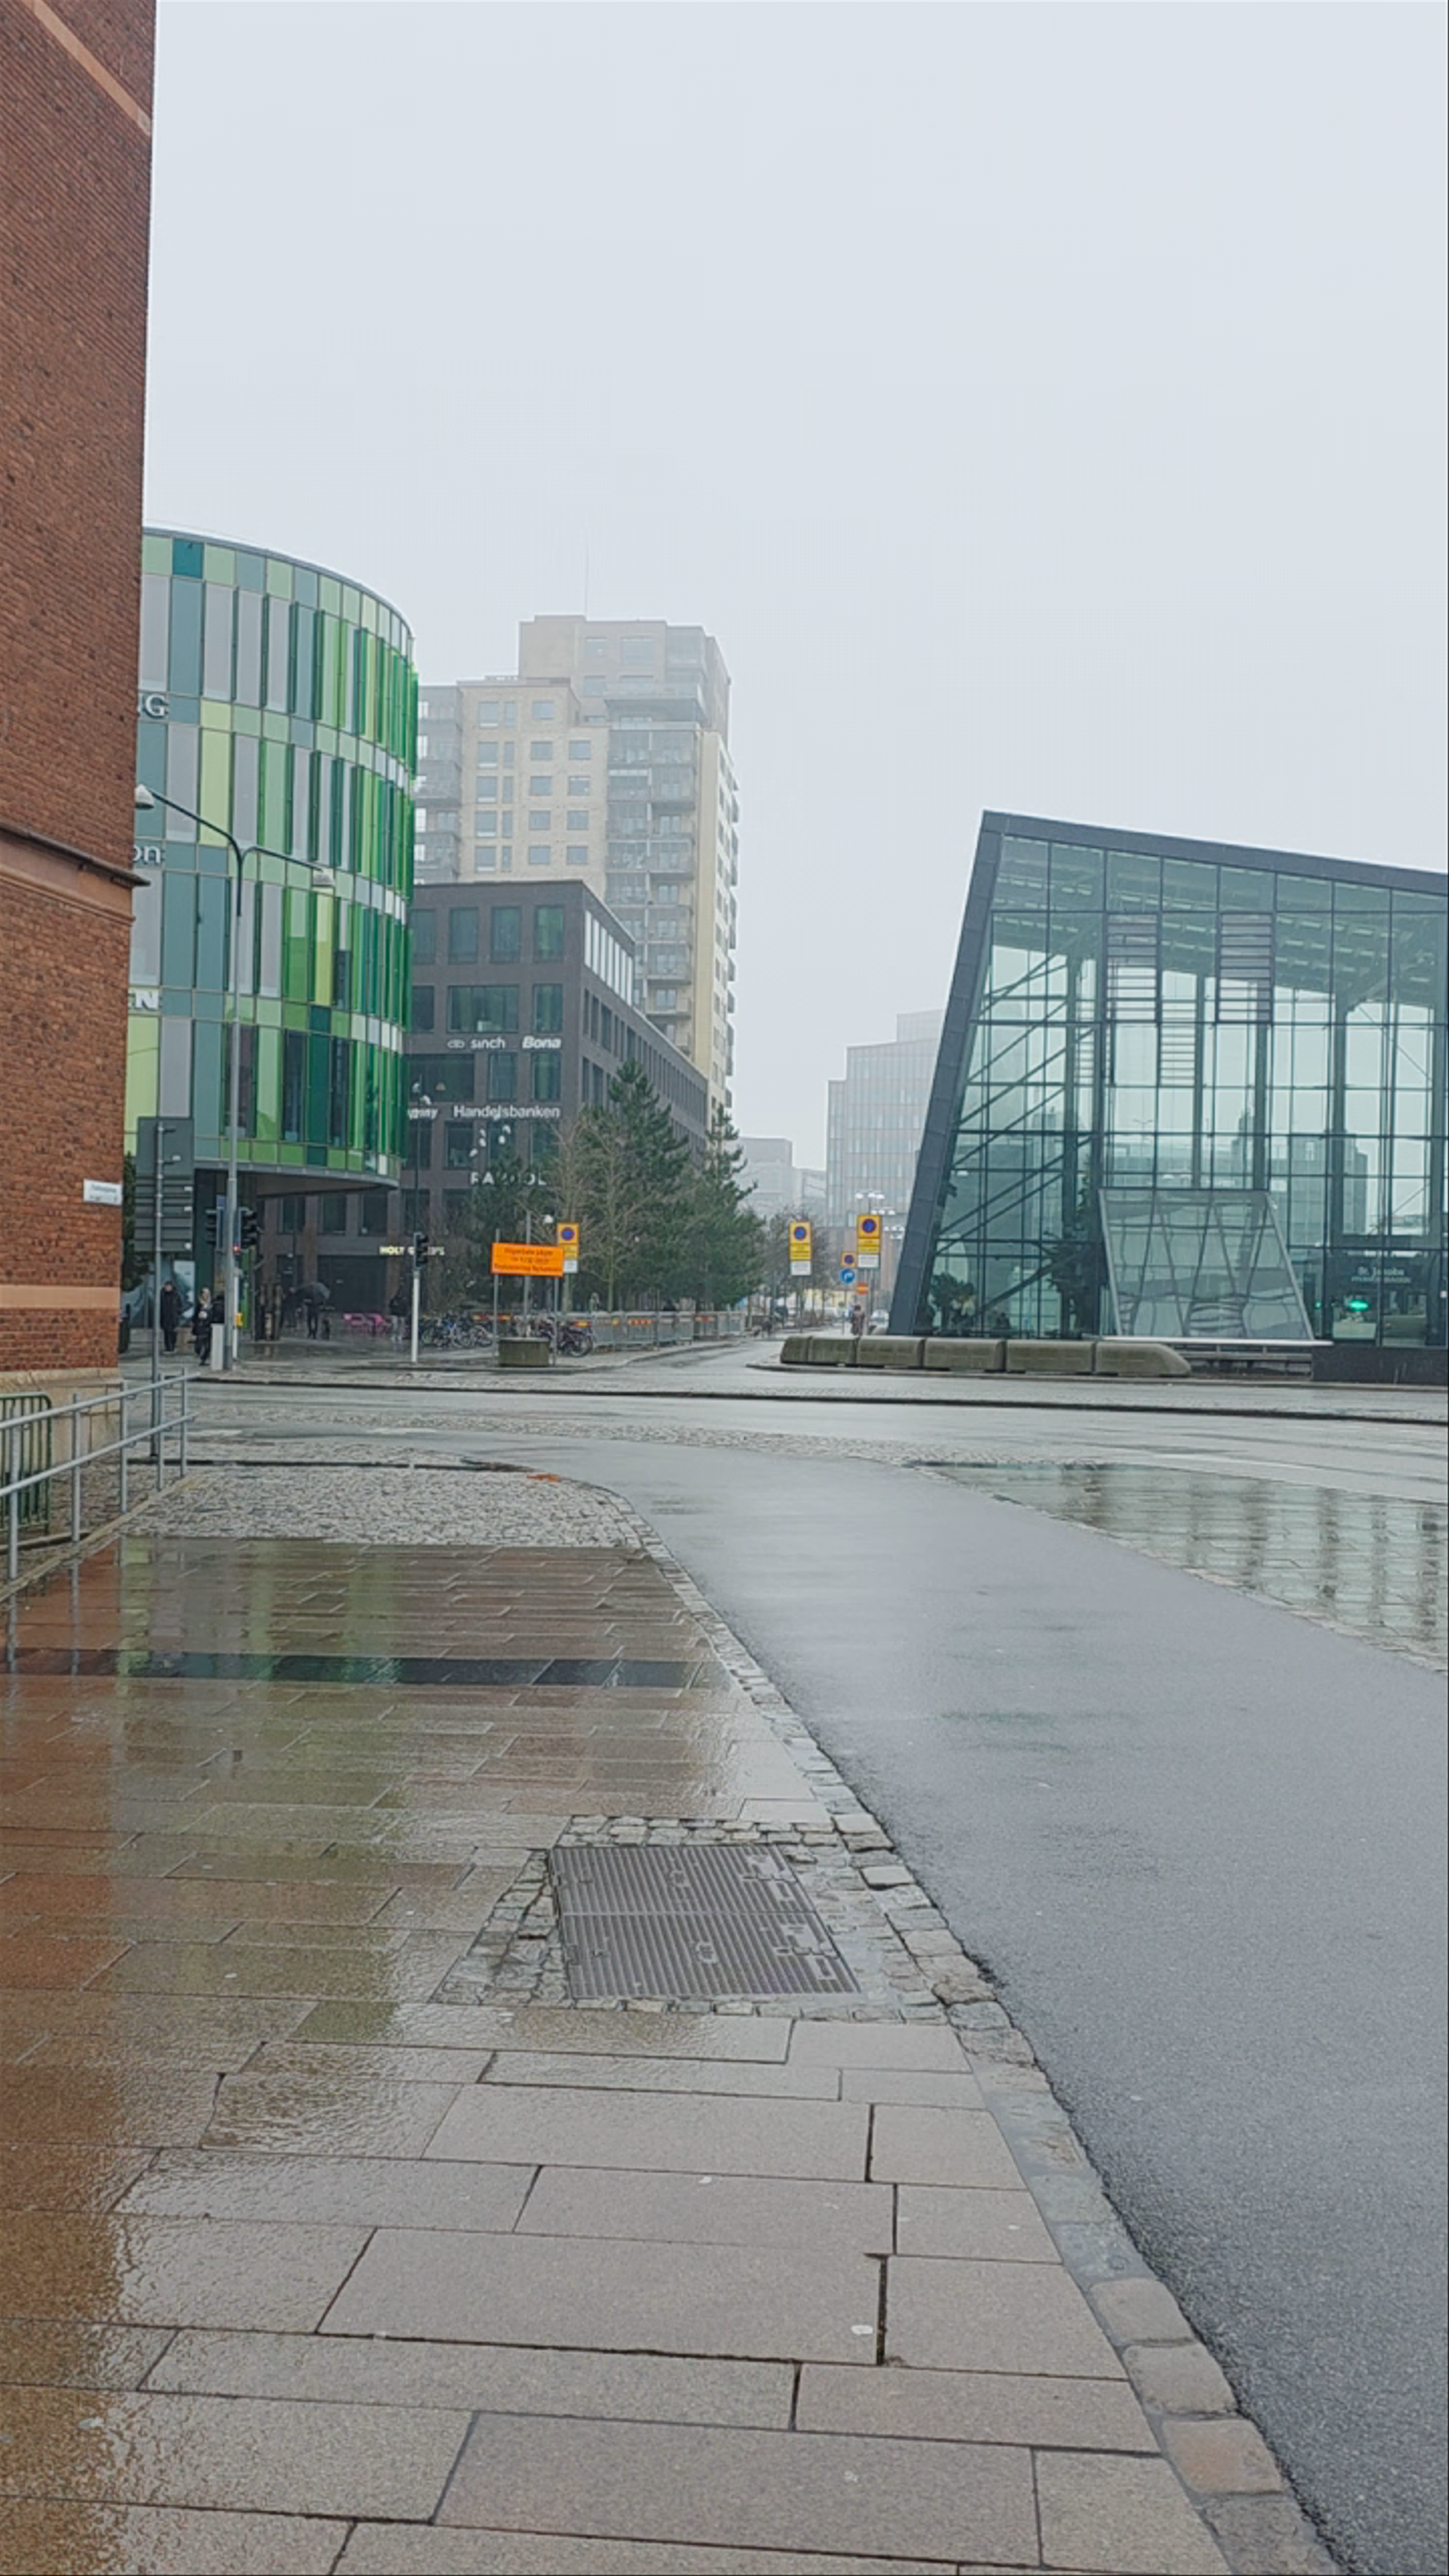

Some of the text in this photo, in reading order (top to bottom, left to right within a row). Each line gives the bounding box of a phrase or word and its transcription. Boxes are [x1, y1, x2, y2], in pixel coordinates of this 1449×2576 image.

[471, 1037, 506, 1049] sinch
[522, 1035, 561, 1049] Bona
[454, 1105, 560, 1119] Handelsbanken
[379, 1246, 405, 1256] HOLY
